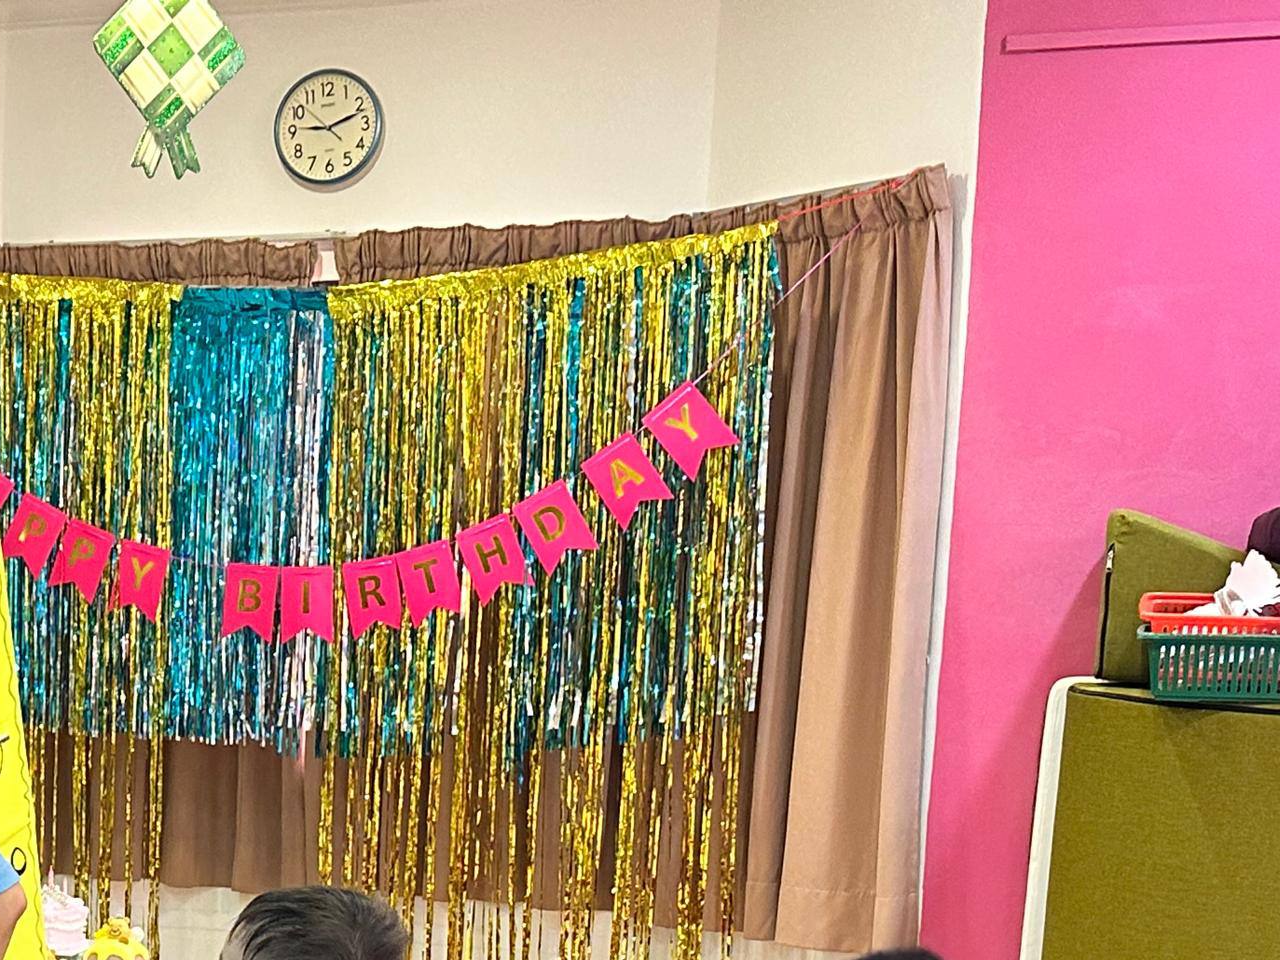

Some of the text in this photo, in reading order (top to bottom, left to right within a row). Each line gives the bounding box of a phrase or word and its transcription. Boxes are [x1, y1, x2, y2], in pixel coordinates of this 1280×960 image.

[305, 89, 315, 105] 11
[320, 81, 335, 97] 12
[343, 84, 348, 100] 1
[292, 104, 305, 120] 10
[354, 96, 366, 112] 2
[360, 115, 370, 131] 3
[287, 124, 297, 140] 9
[294, 143, 303, 159] 8
[355, 136, 365, 150] 4
[307, 155, 317, 171] 7
[325, 158, 335, 173] 6
[343, 151, 353, 166] 5
[238, 403, 700, 614] BIRTHDAY
